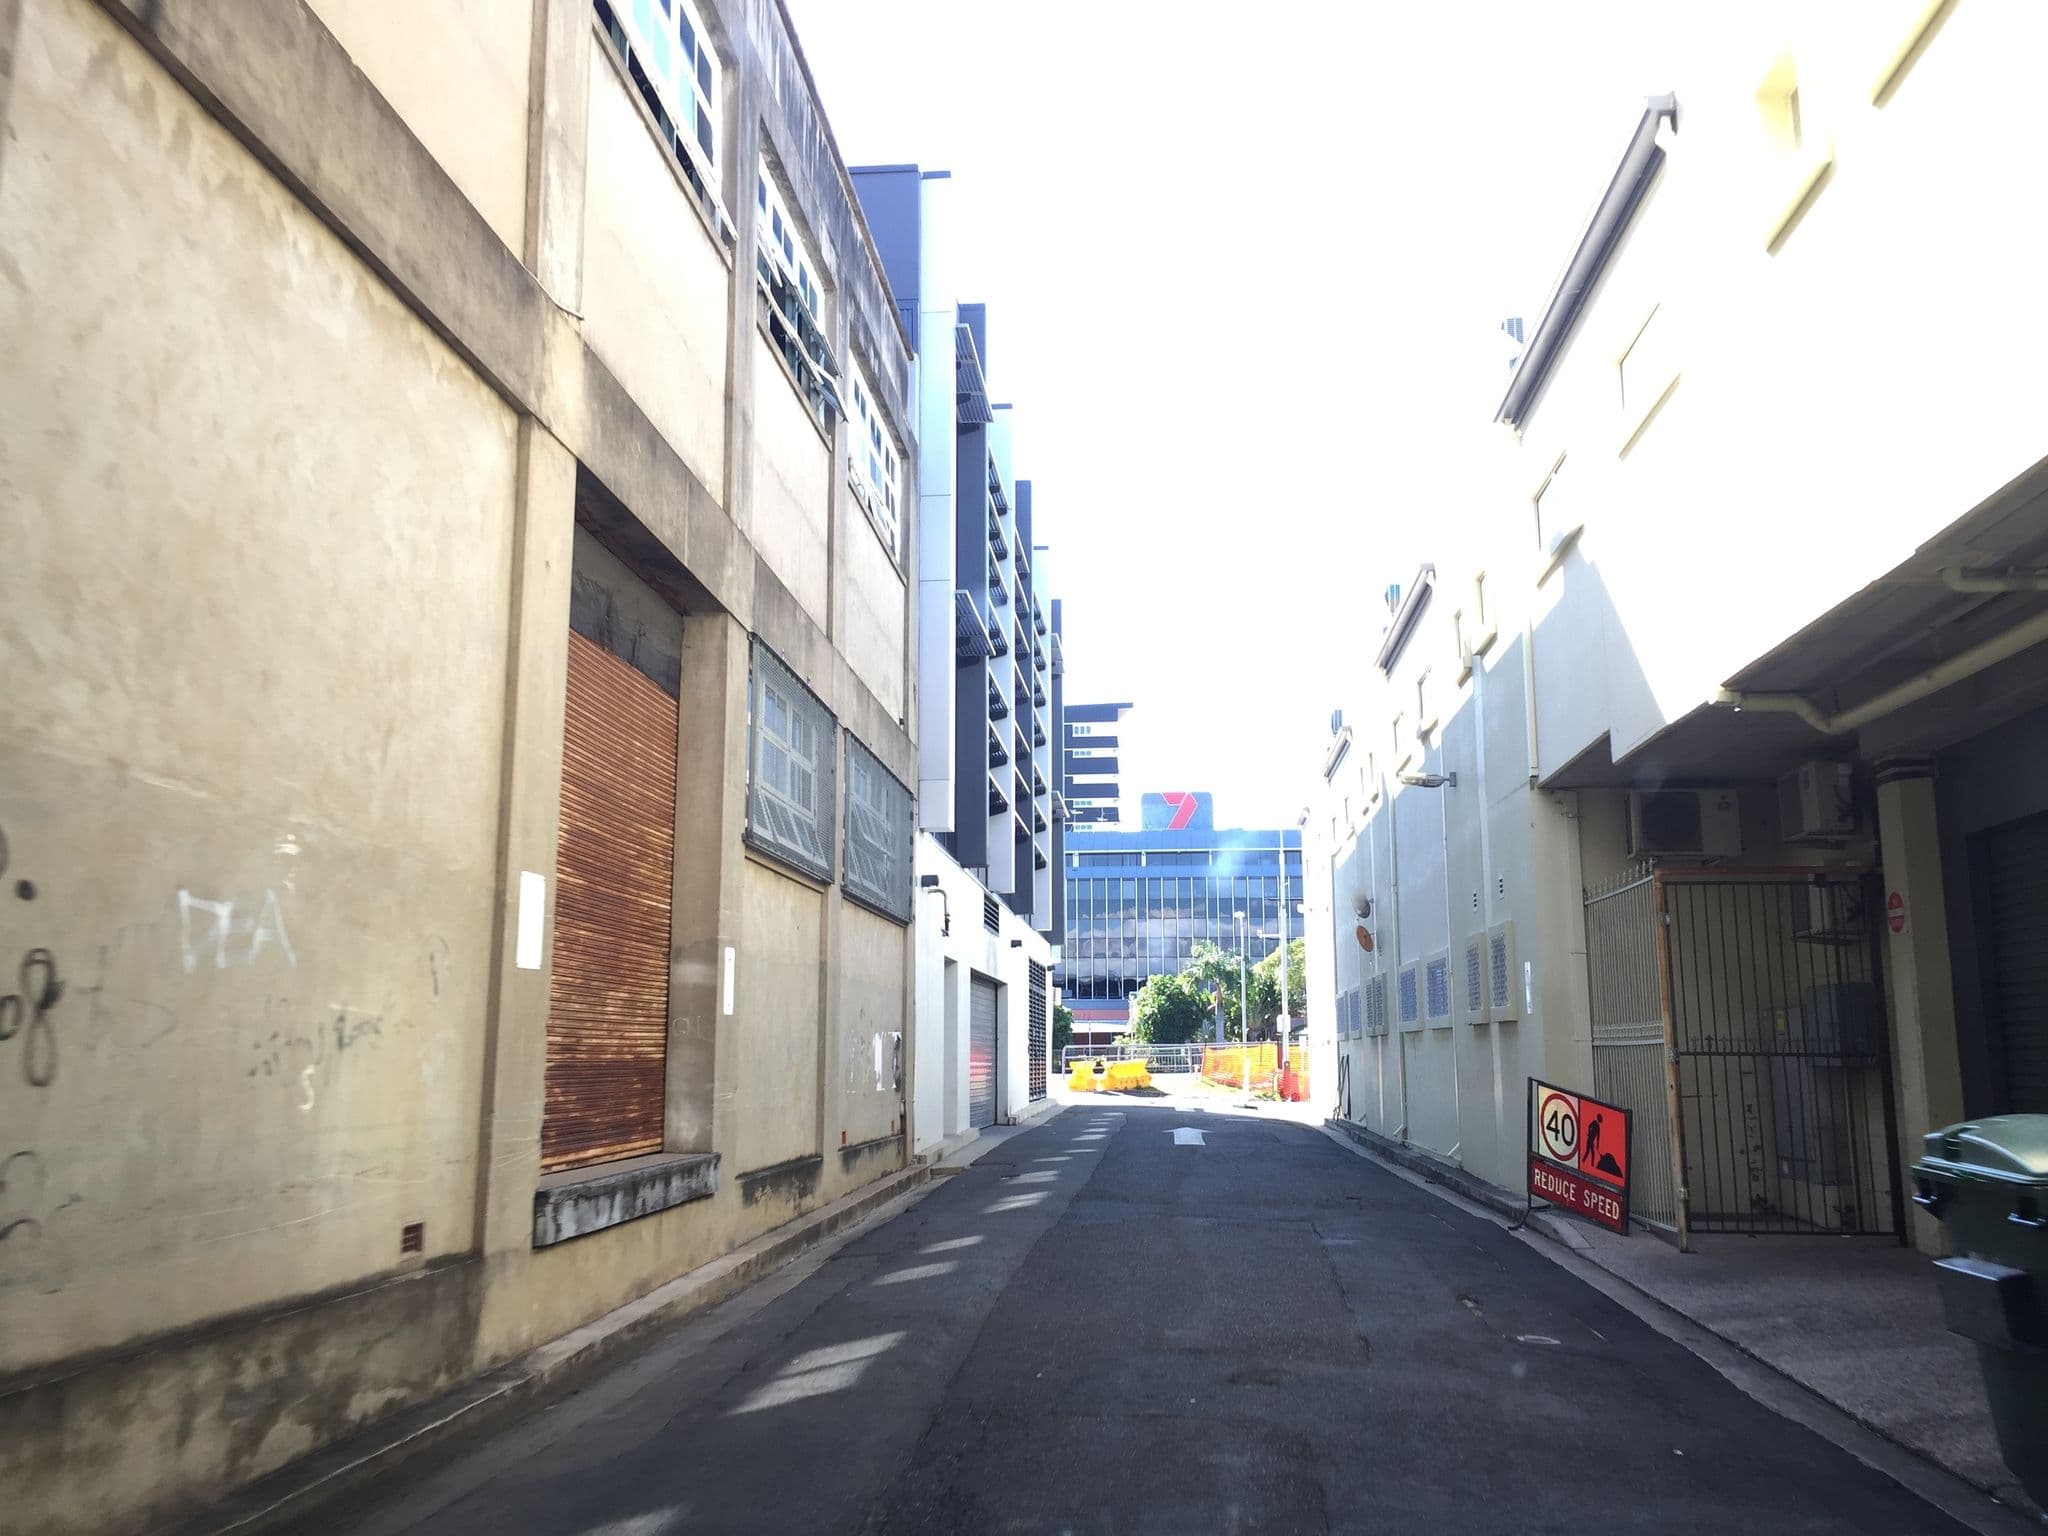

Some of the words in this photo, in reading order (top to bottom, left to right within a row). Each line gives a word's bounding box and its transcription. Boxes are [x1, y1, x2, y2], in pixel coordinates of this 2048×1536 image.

[1161, 792, 1198, 830] 7
[1546, 1110, 1575, 1147] 40
[1534, 1168, 1577, 1202] REDUCE
[1583, 1188, 1620, 1220] SPEED
